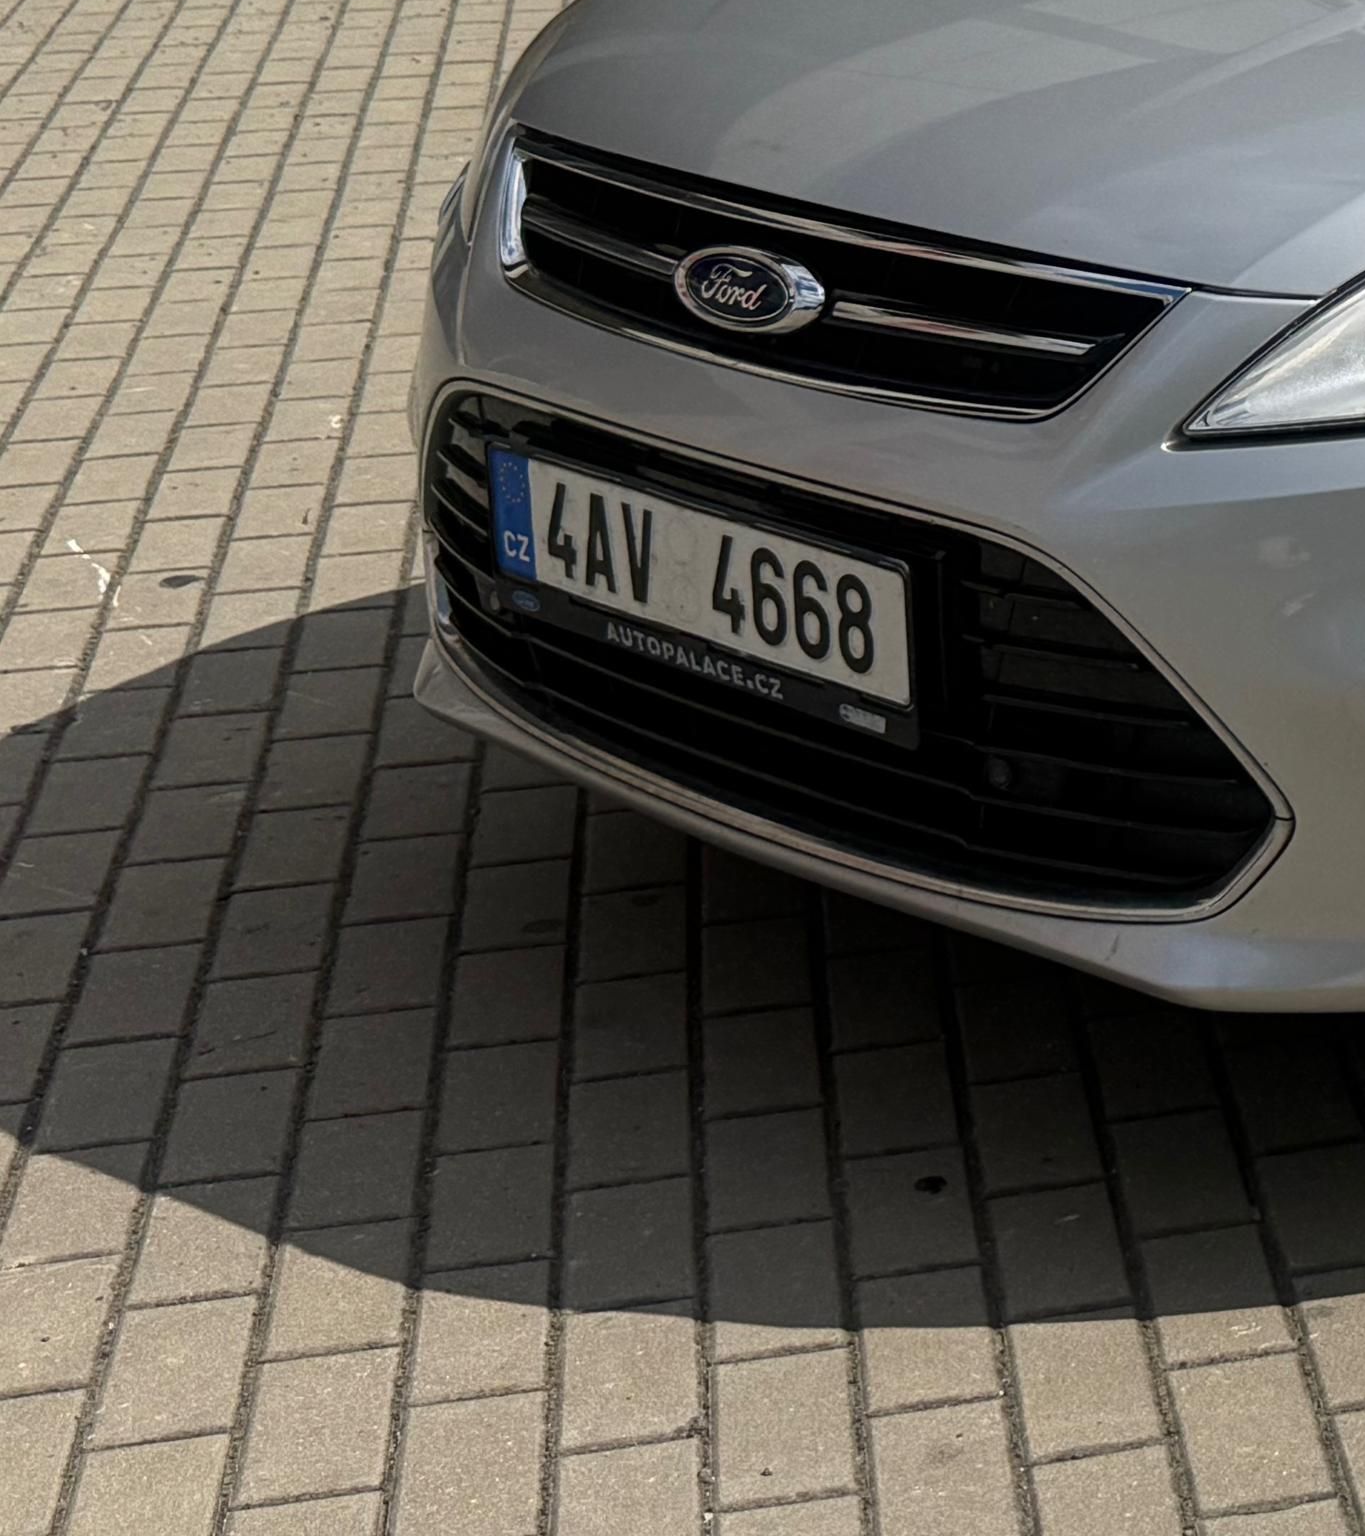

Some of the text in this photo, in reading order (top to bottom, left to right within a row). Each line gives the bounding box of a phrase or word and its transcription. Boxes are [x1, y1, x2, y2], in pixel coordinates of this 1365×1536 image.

[701, 263, 768, 311] Ford
[503, 481, 875, 674] CZ 4AV 4668
[606, 621, 784, 700] AUTOPALACE.CZ
